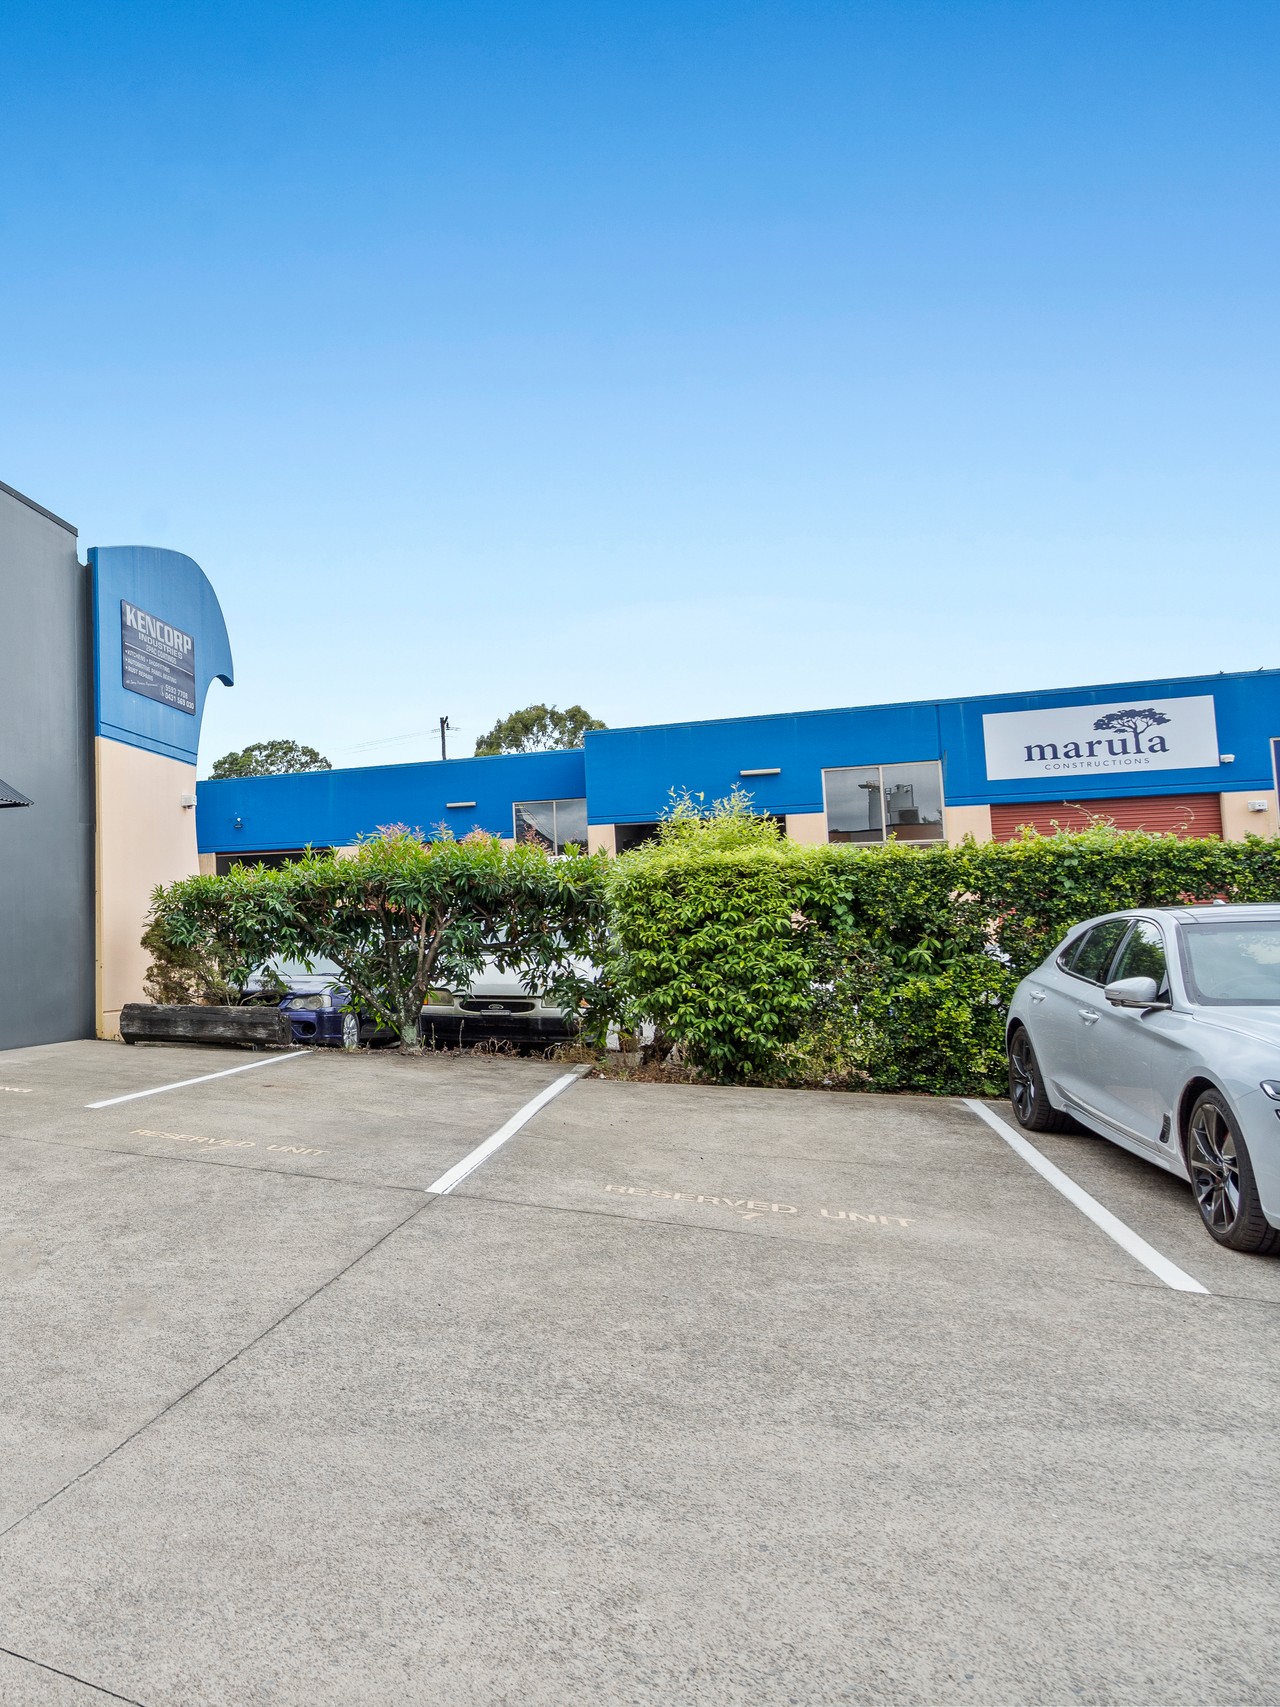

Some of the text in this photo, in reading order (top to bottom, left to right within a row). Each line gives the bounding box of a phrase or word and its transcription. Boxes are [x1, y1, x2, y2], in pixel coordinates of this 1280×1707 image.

[125, 604, 192, 655] KENCORP
[138, 632, 183, 660] INDUSTRIES
[157, 649, 177, 665] COATINGS
[1024, 731, 1170, 762] marula
[1044, 757, 1150, 771] CONSTRUCTIONS
[128, 1128, 331, 1157] RESERVED UNIT
[603, 1184, 917, 1228] RESERVED UNIT
[735, 1209, 765, 1221] 7
